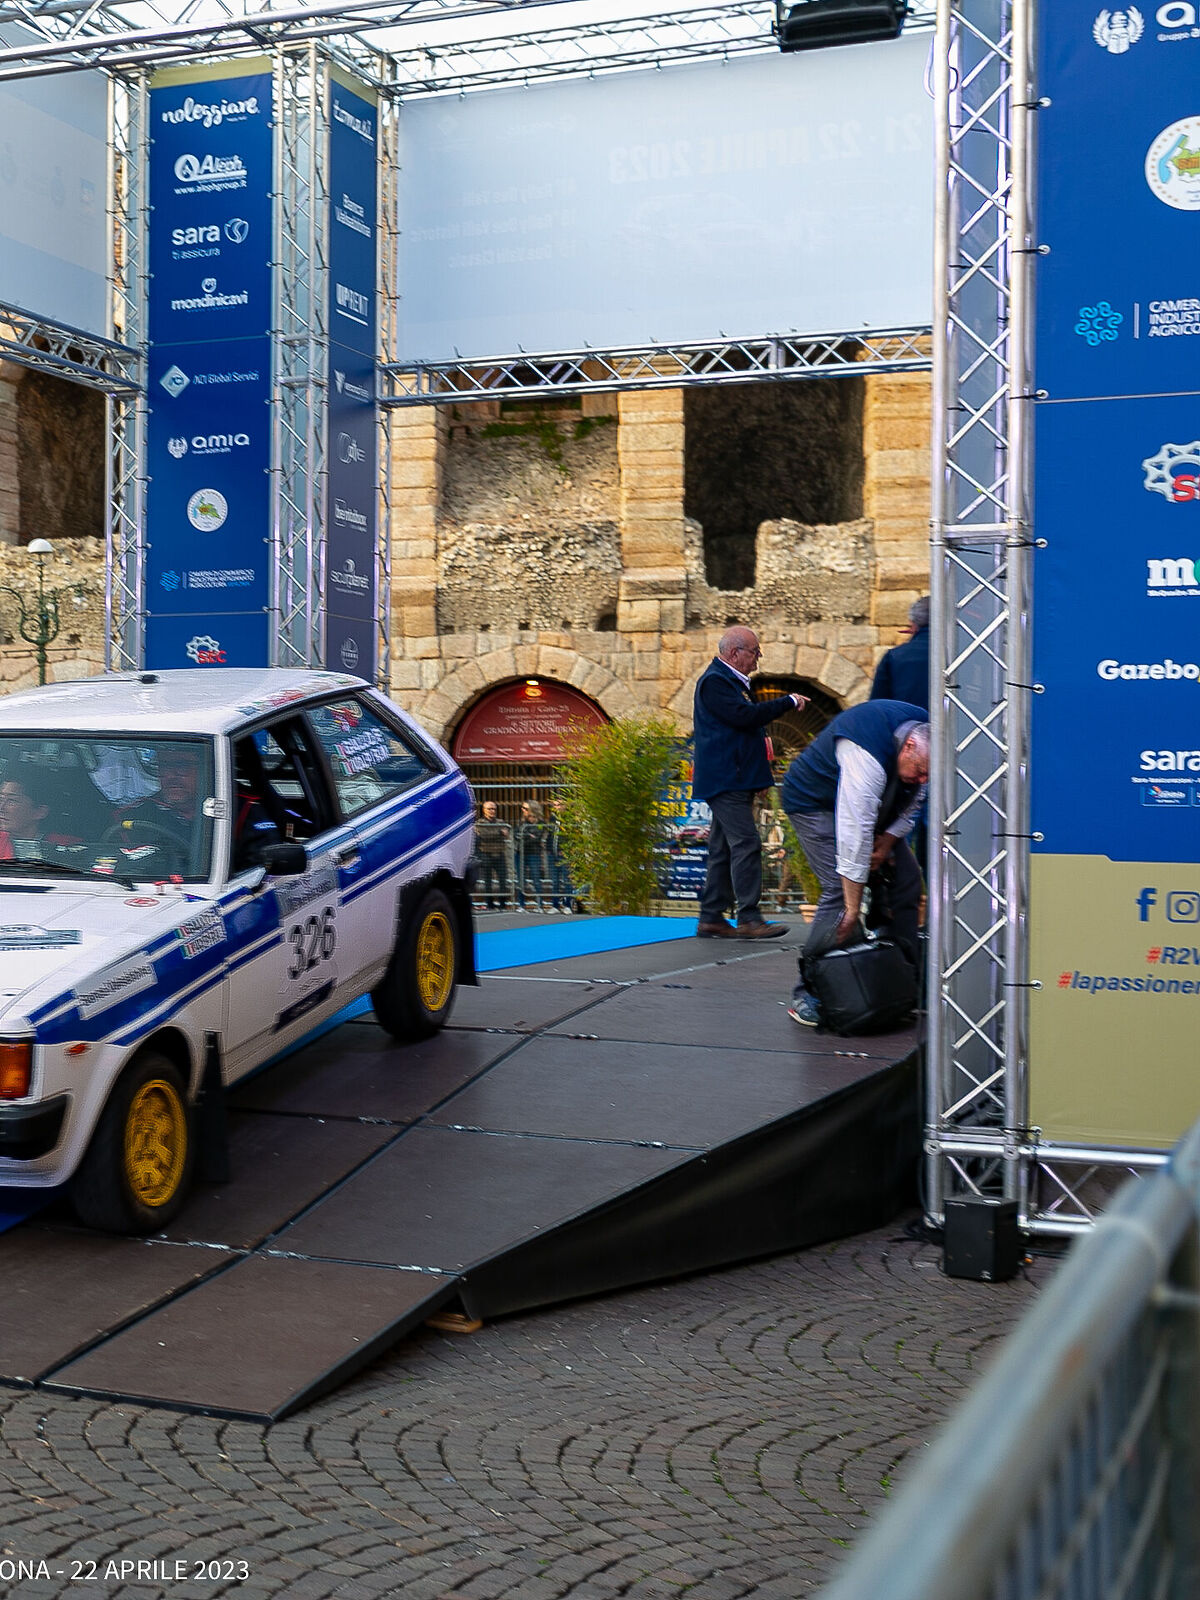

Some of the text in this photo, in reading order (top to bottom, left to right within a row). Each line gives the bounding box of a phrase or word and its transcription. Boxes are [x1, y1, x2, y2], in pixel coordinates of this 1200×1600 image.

[161, 97, 260, 128] noleggiare
[172, 225, 220, 245] sara
[191, 433, 250, 449] amia
[1097, 659, 1200, 680] Gazebo
[286, 906, 337, 980] 326
